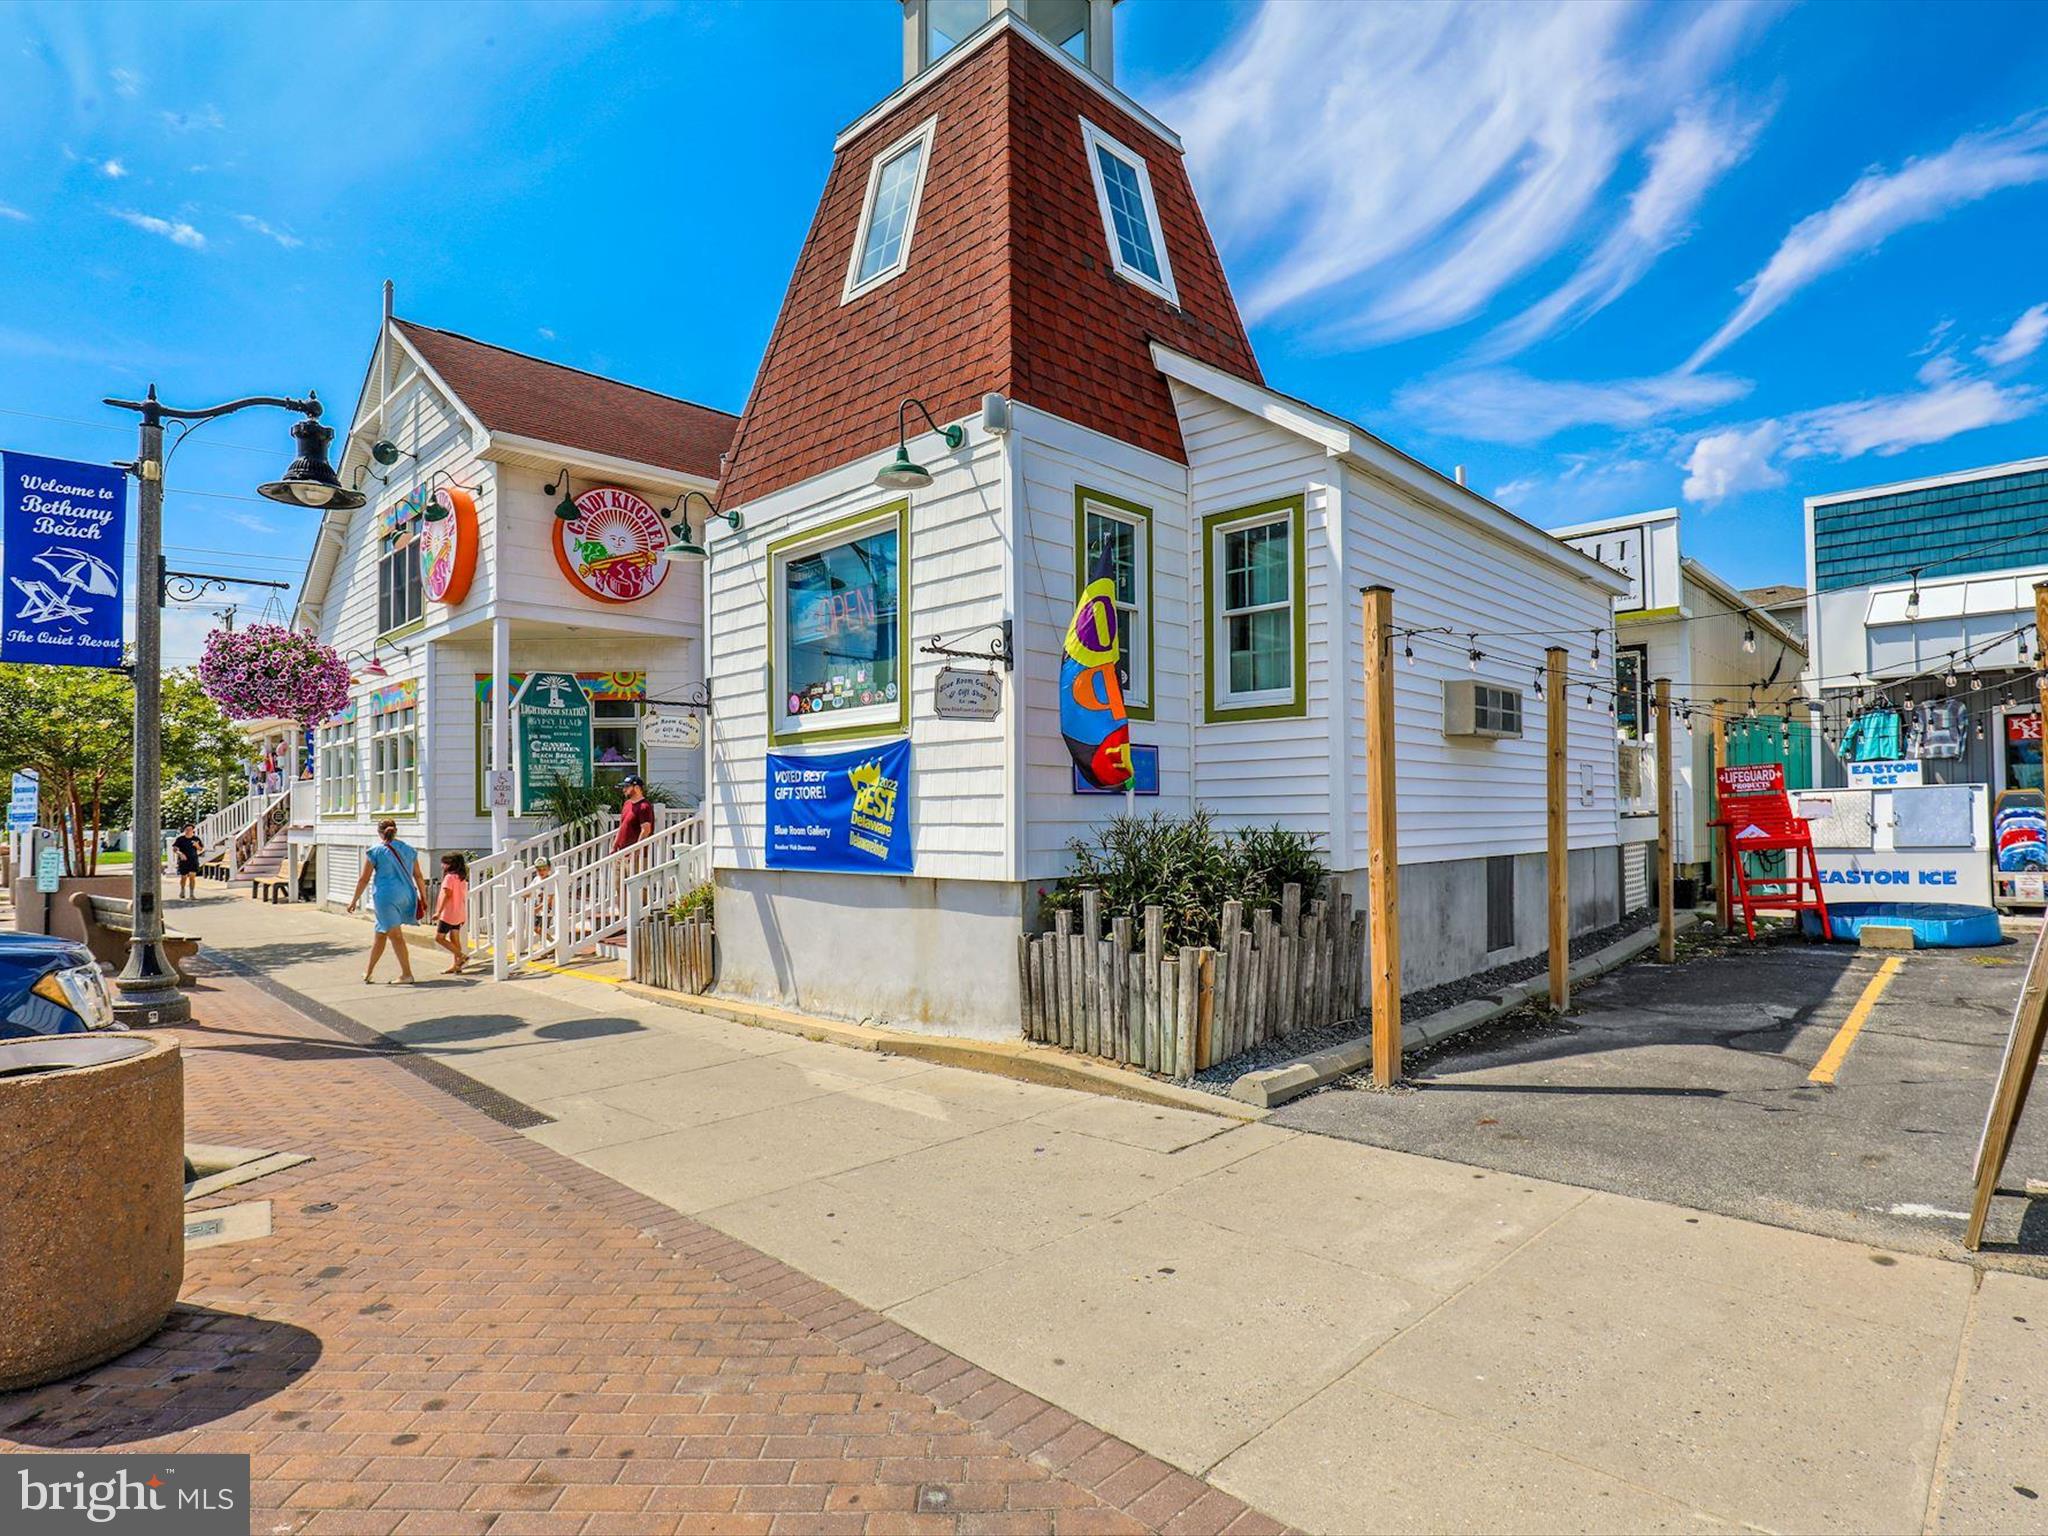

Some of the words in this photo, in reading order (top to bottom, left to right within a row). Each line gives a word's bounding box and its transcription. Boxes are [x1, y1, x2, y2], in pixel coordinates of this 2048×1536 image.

[20, 474, 96, 498] Welcome
[98, 487, 114, 500] to
[20, 494, 114, 526] Bethany
[33, 516, 102, 540] Beach
[566, 490, 608, 535] CANDY
[611, 490, 666, 552] KITCHEN
[816, 586, 875, 636] OPEN
[6, 629, 34, 643] The
[37, 631, 74, 647] Quiet
[76, 634, 121, 649] Resort
[955, 677, 974, 685] Room
[561, 705, 588, 716] STATION
[774, 770, 801, 784] VOTED
[803, 769, 829, 783] BEST
[1724, 769, 1776, 784] LIFEGUARD
[1851, 762, 1919, 775] EASTON
[880, 776, 899, 791] 2022
[1872, 775, 1898, 785] ICE
[774, 786, 794, 801] GIFT
[794, 785, 827, 800] STORE!
[852, 784, 897, 822] BEST
[774, 824, 788, 835] Blue
[788, 825, 806, 836] Room
[806, 825, 832, 839] Gallery
[851, 811, 893, 837] Delaware
[1819, 869, 1910, 886] EASTON
[1918, 869, 1958, 886] ICE
